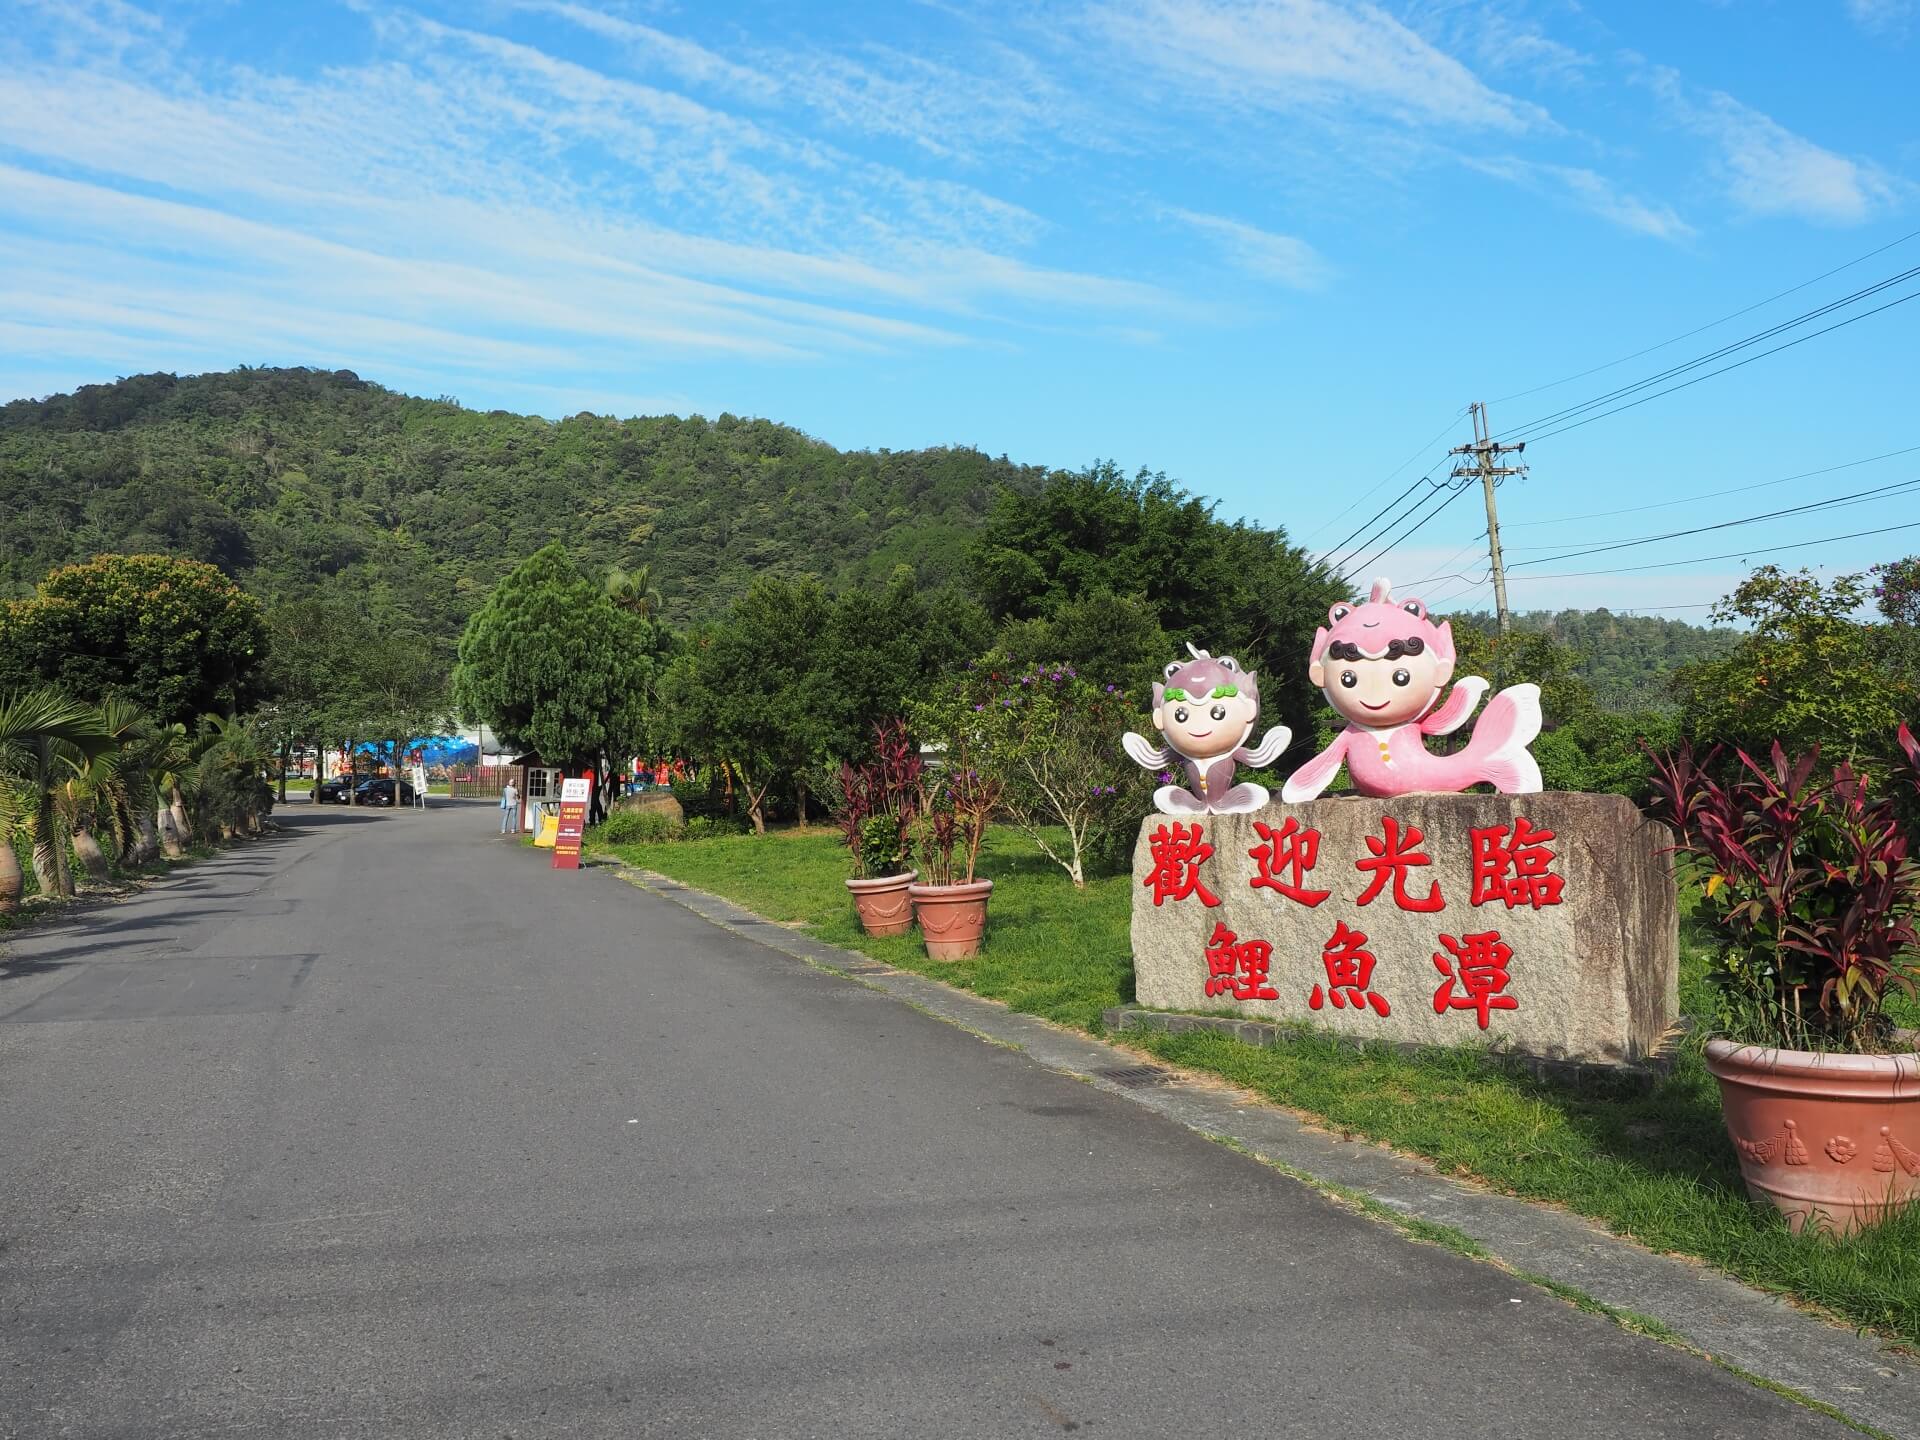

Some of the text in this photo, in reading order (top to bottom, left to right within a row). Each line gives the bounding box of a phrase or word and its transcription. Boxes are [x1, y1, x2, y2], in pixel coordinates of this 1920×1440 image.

[1143, 816, 1566, 912] 歡迎光臨
[1204, 921, 1519, 1030] 鯉魚潭
